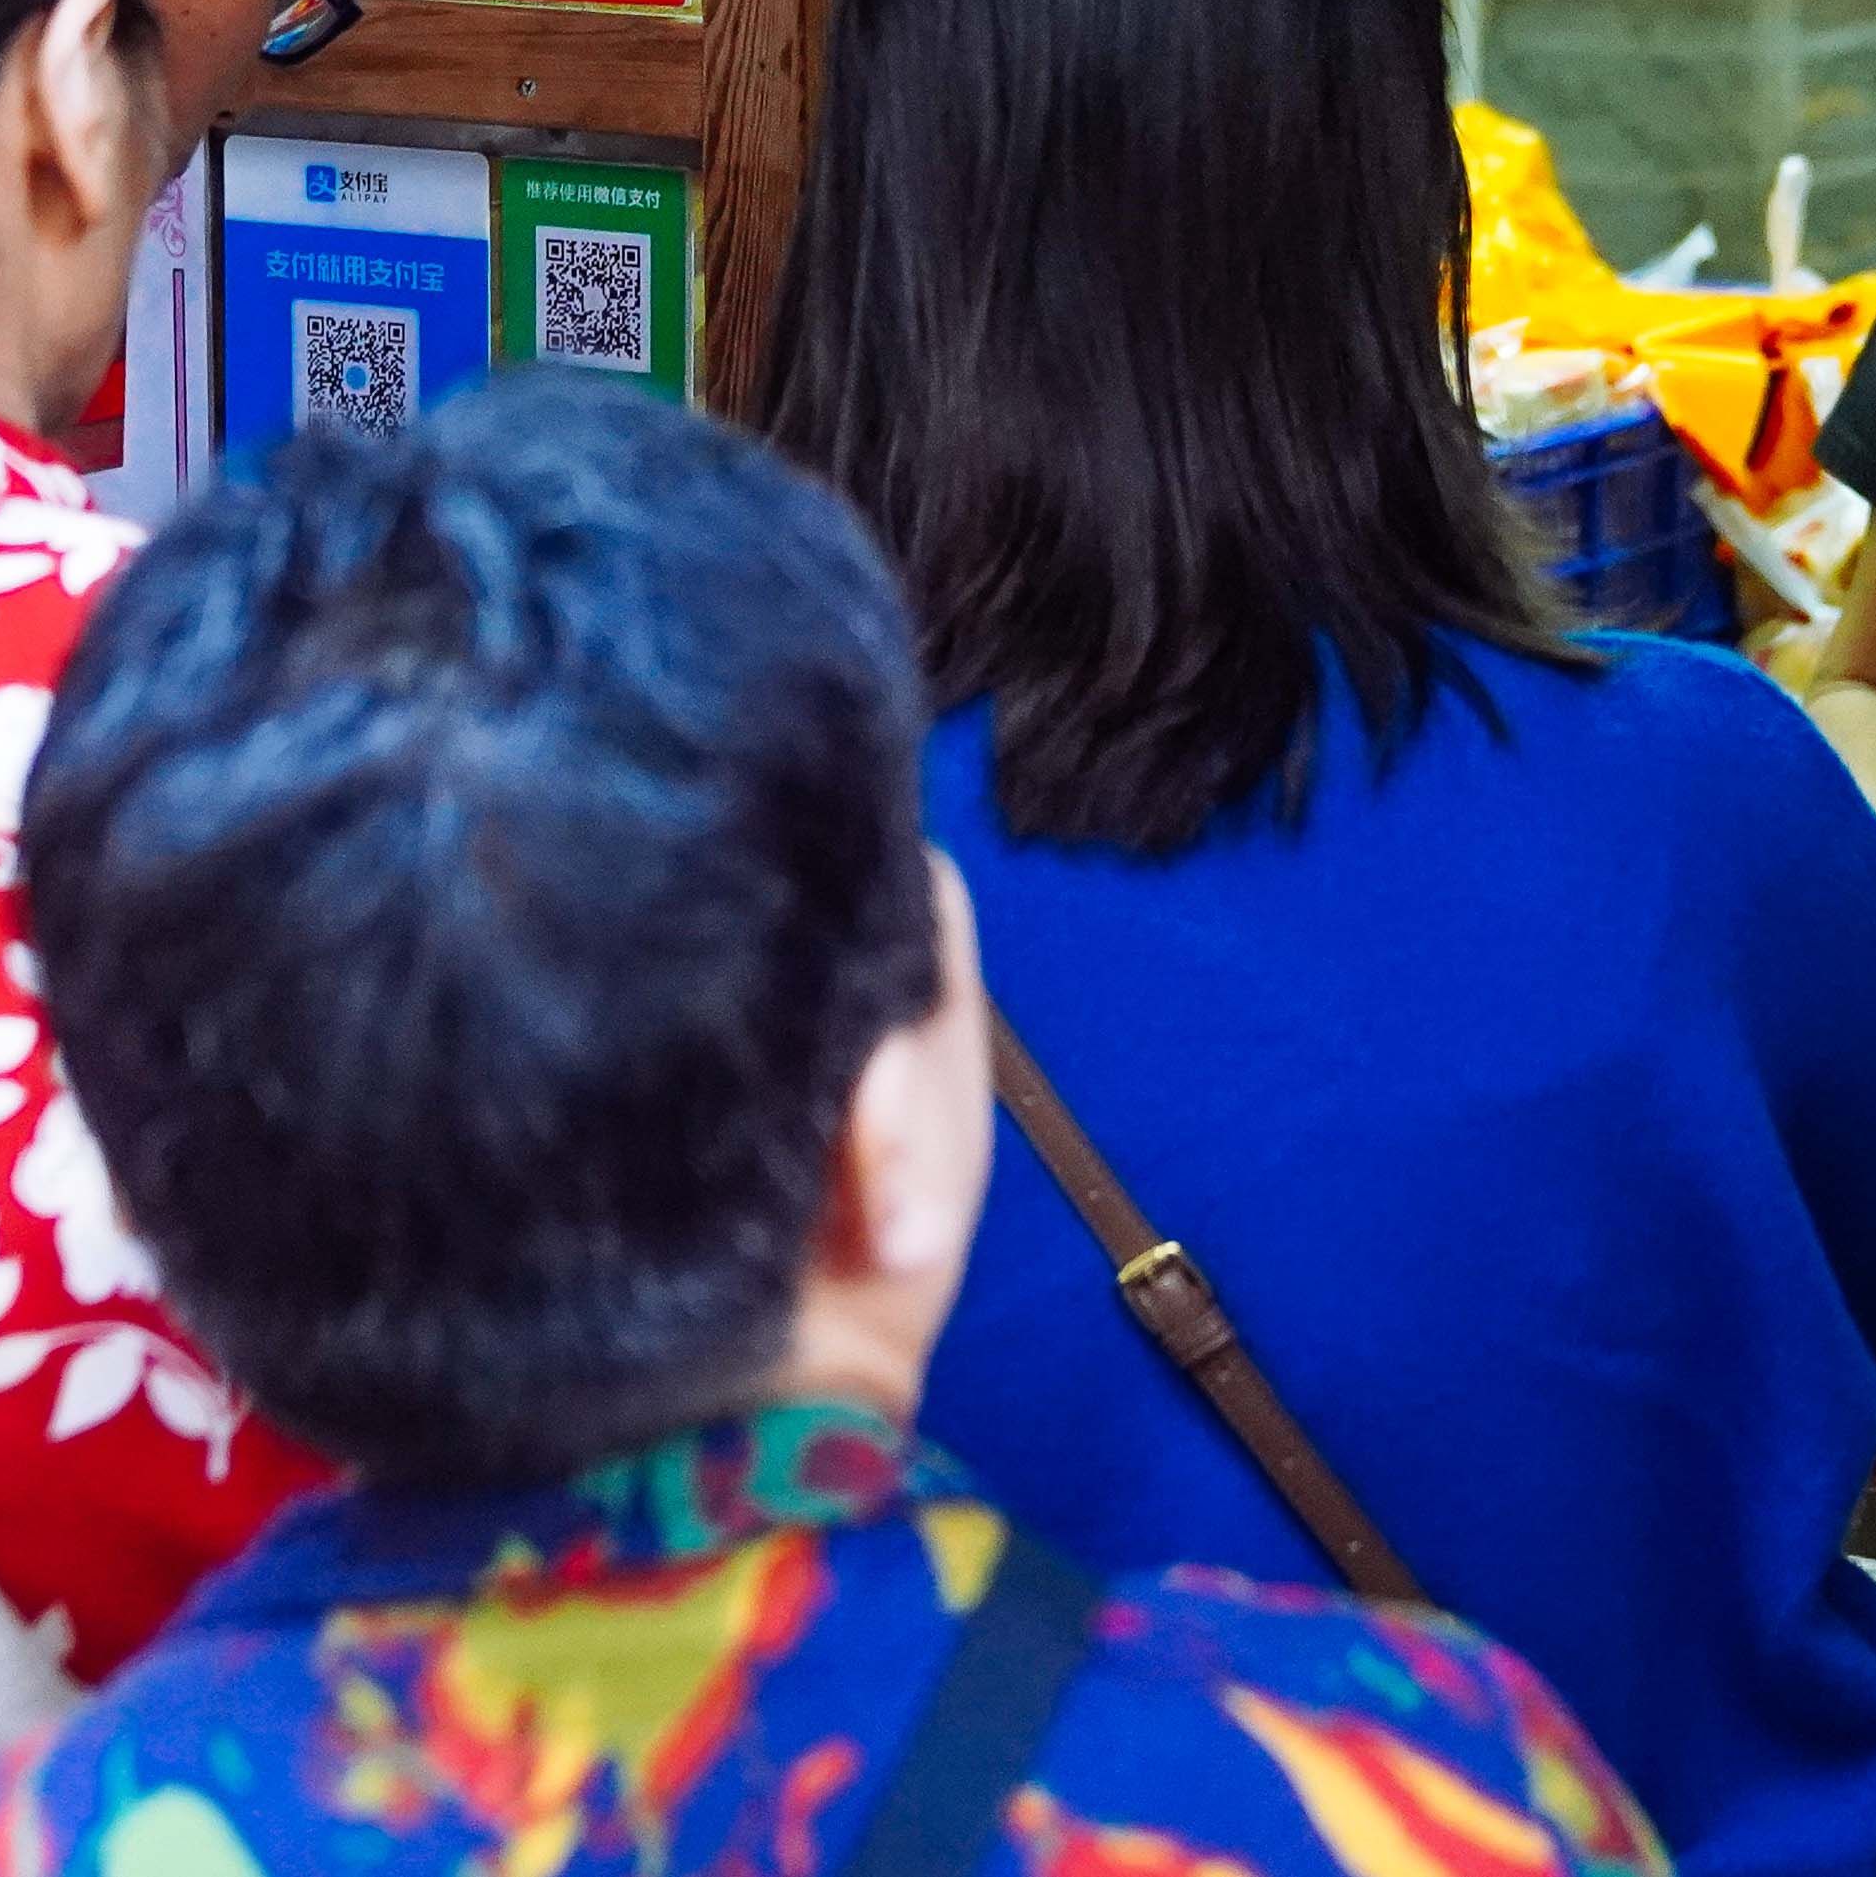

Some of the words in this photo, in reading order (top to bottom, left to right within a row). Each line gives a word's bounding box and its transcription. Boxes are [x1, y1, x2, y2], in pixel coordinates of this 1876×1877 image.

[339, 170, 388, 195] 支付宝
[526, 179, 661, 210] 推荐使用微信支付
[341, 192, 388, 204] ALIPAY
[266, 250, 445, 293] 支付就用支付宝
